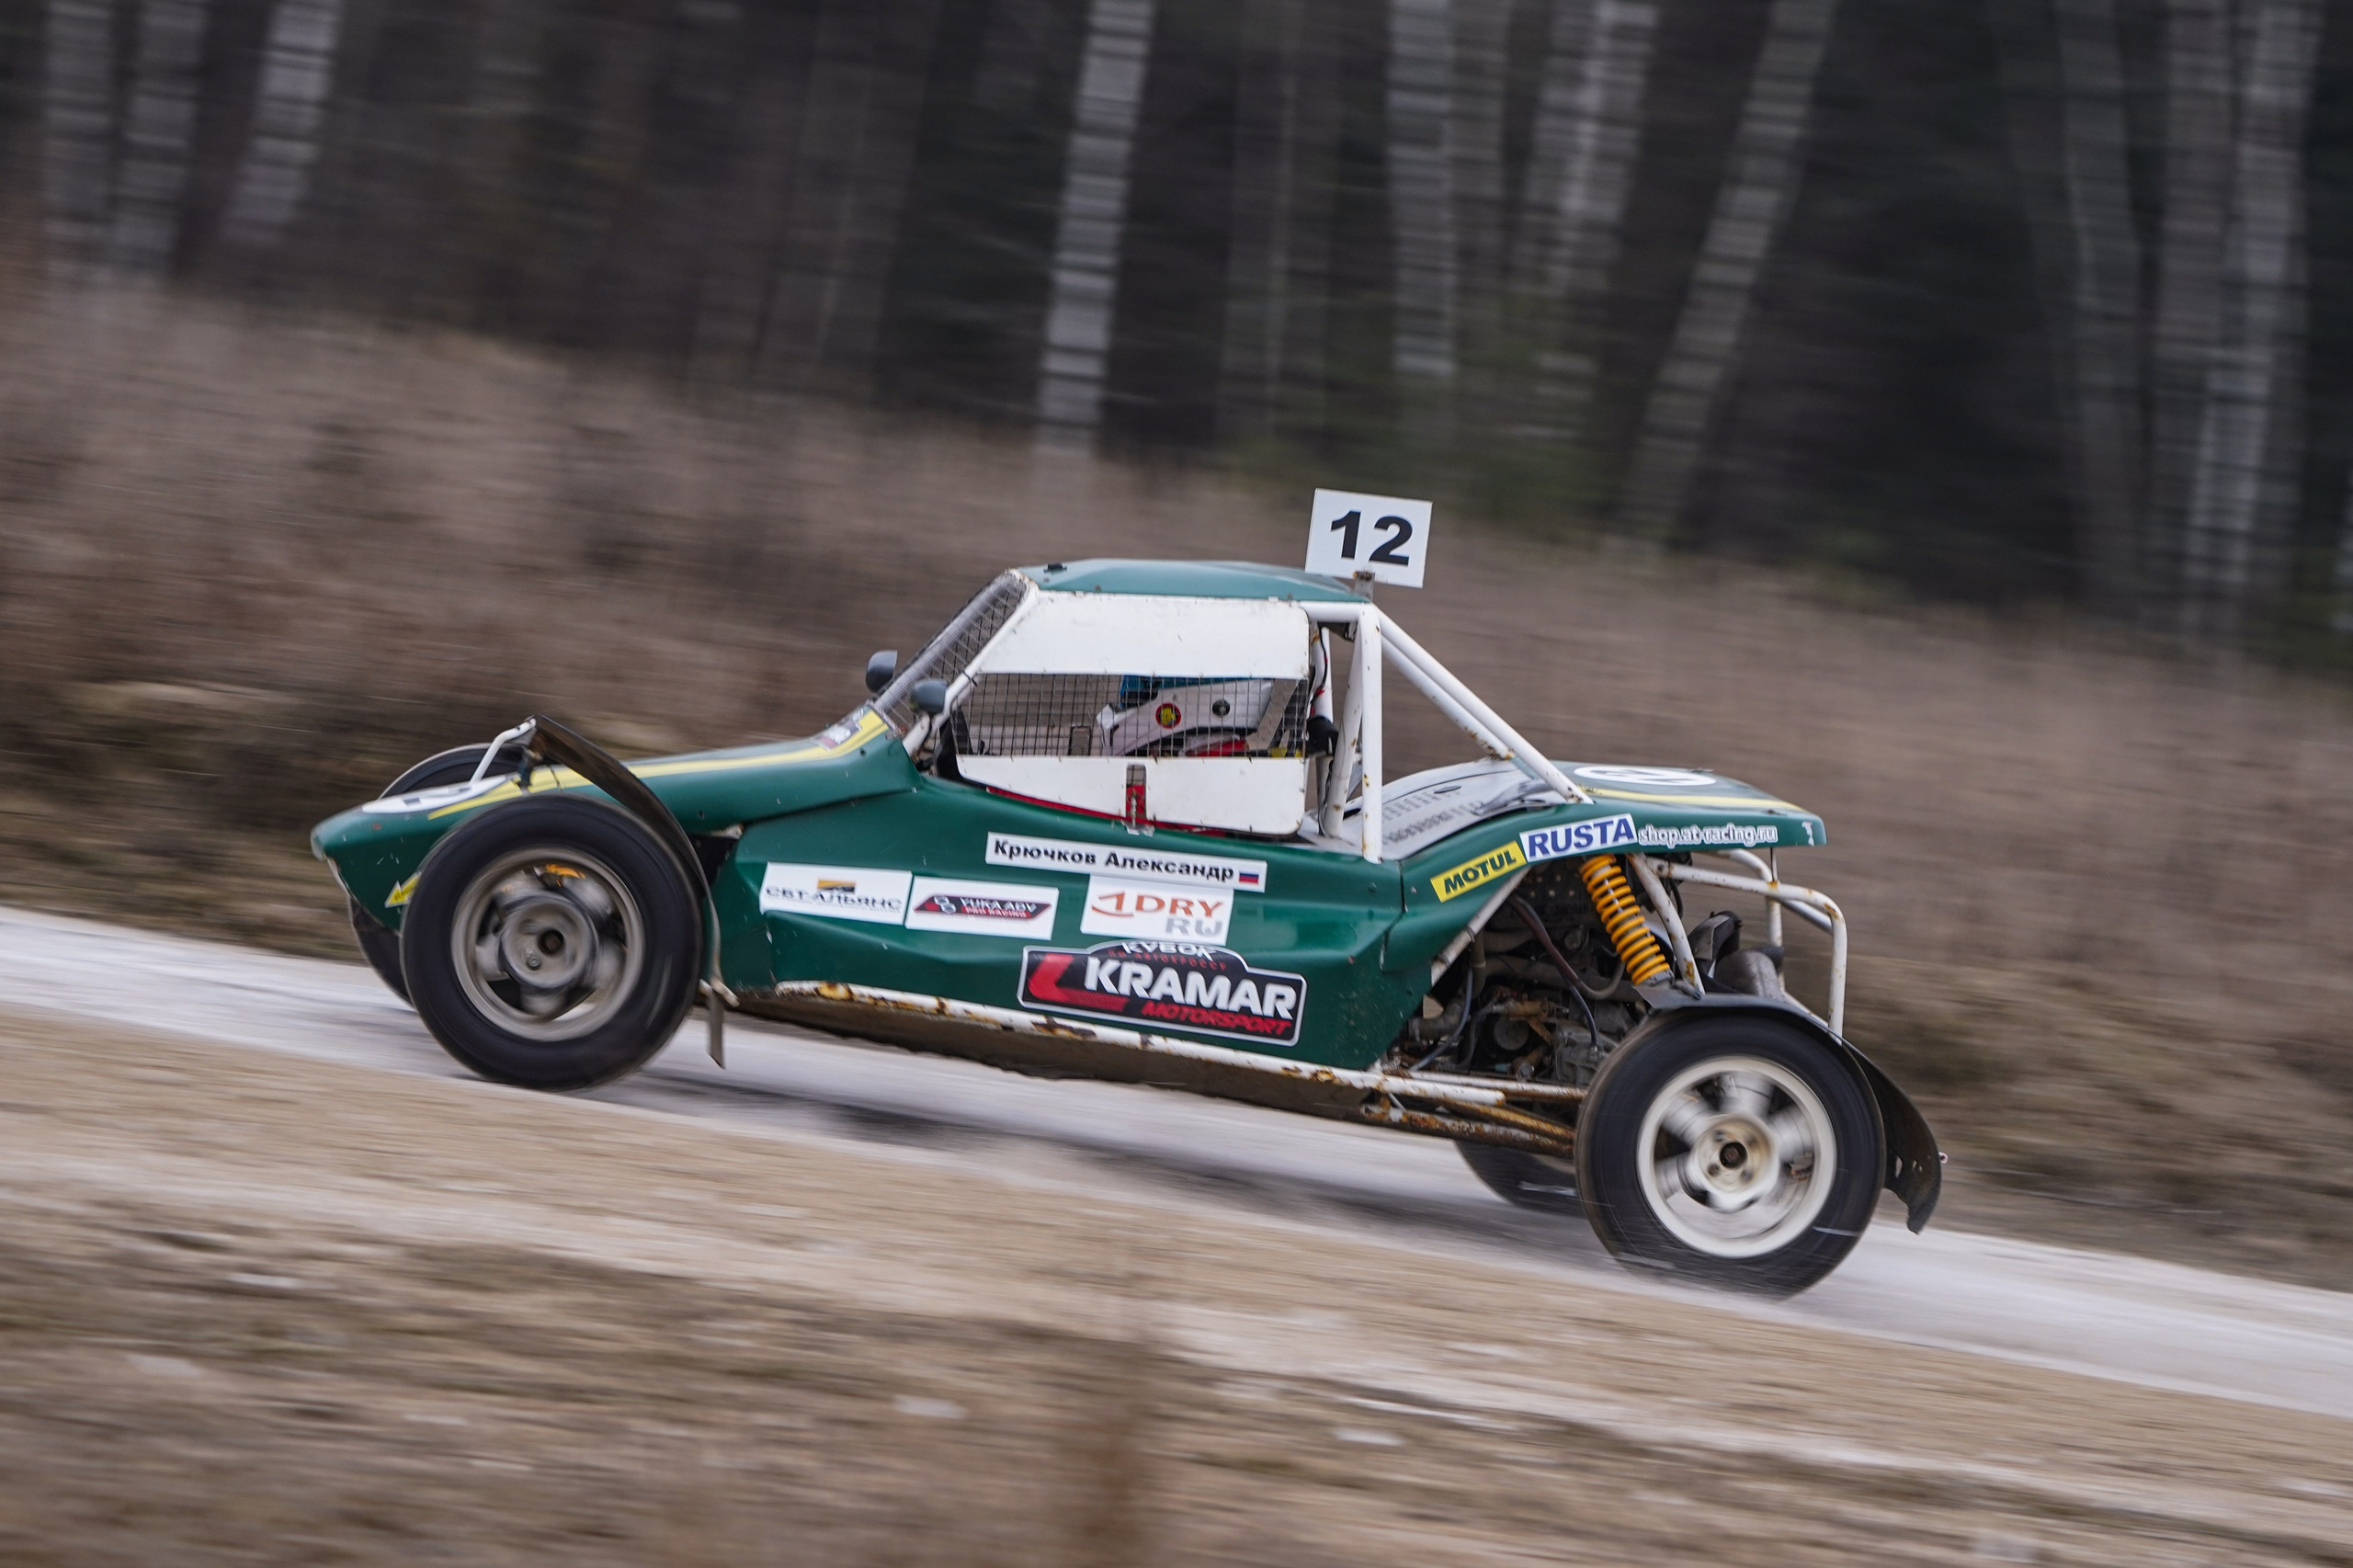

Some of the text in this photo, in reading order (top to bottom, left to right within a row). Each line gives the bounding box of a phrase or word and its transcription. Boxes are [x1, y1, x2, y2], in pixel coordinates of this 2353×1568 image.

[1331, 510, 1413, 567] 12
[1528, 817, 1634, 858] RUSTA
[1639, 823, 1778, 848] shop.at-racing.ru
[995, 838, 1234, 882] Крючков Александр
[1444, 850, 1517, 895] MOTUL
[1084, 956, 1297, 1020] KRAMAR
[1141, 1001, 1292, 1037] MOTORSPORT
